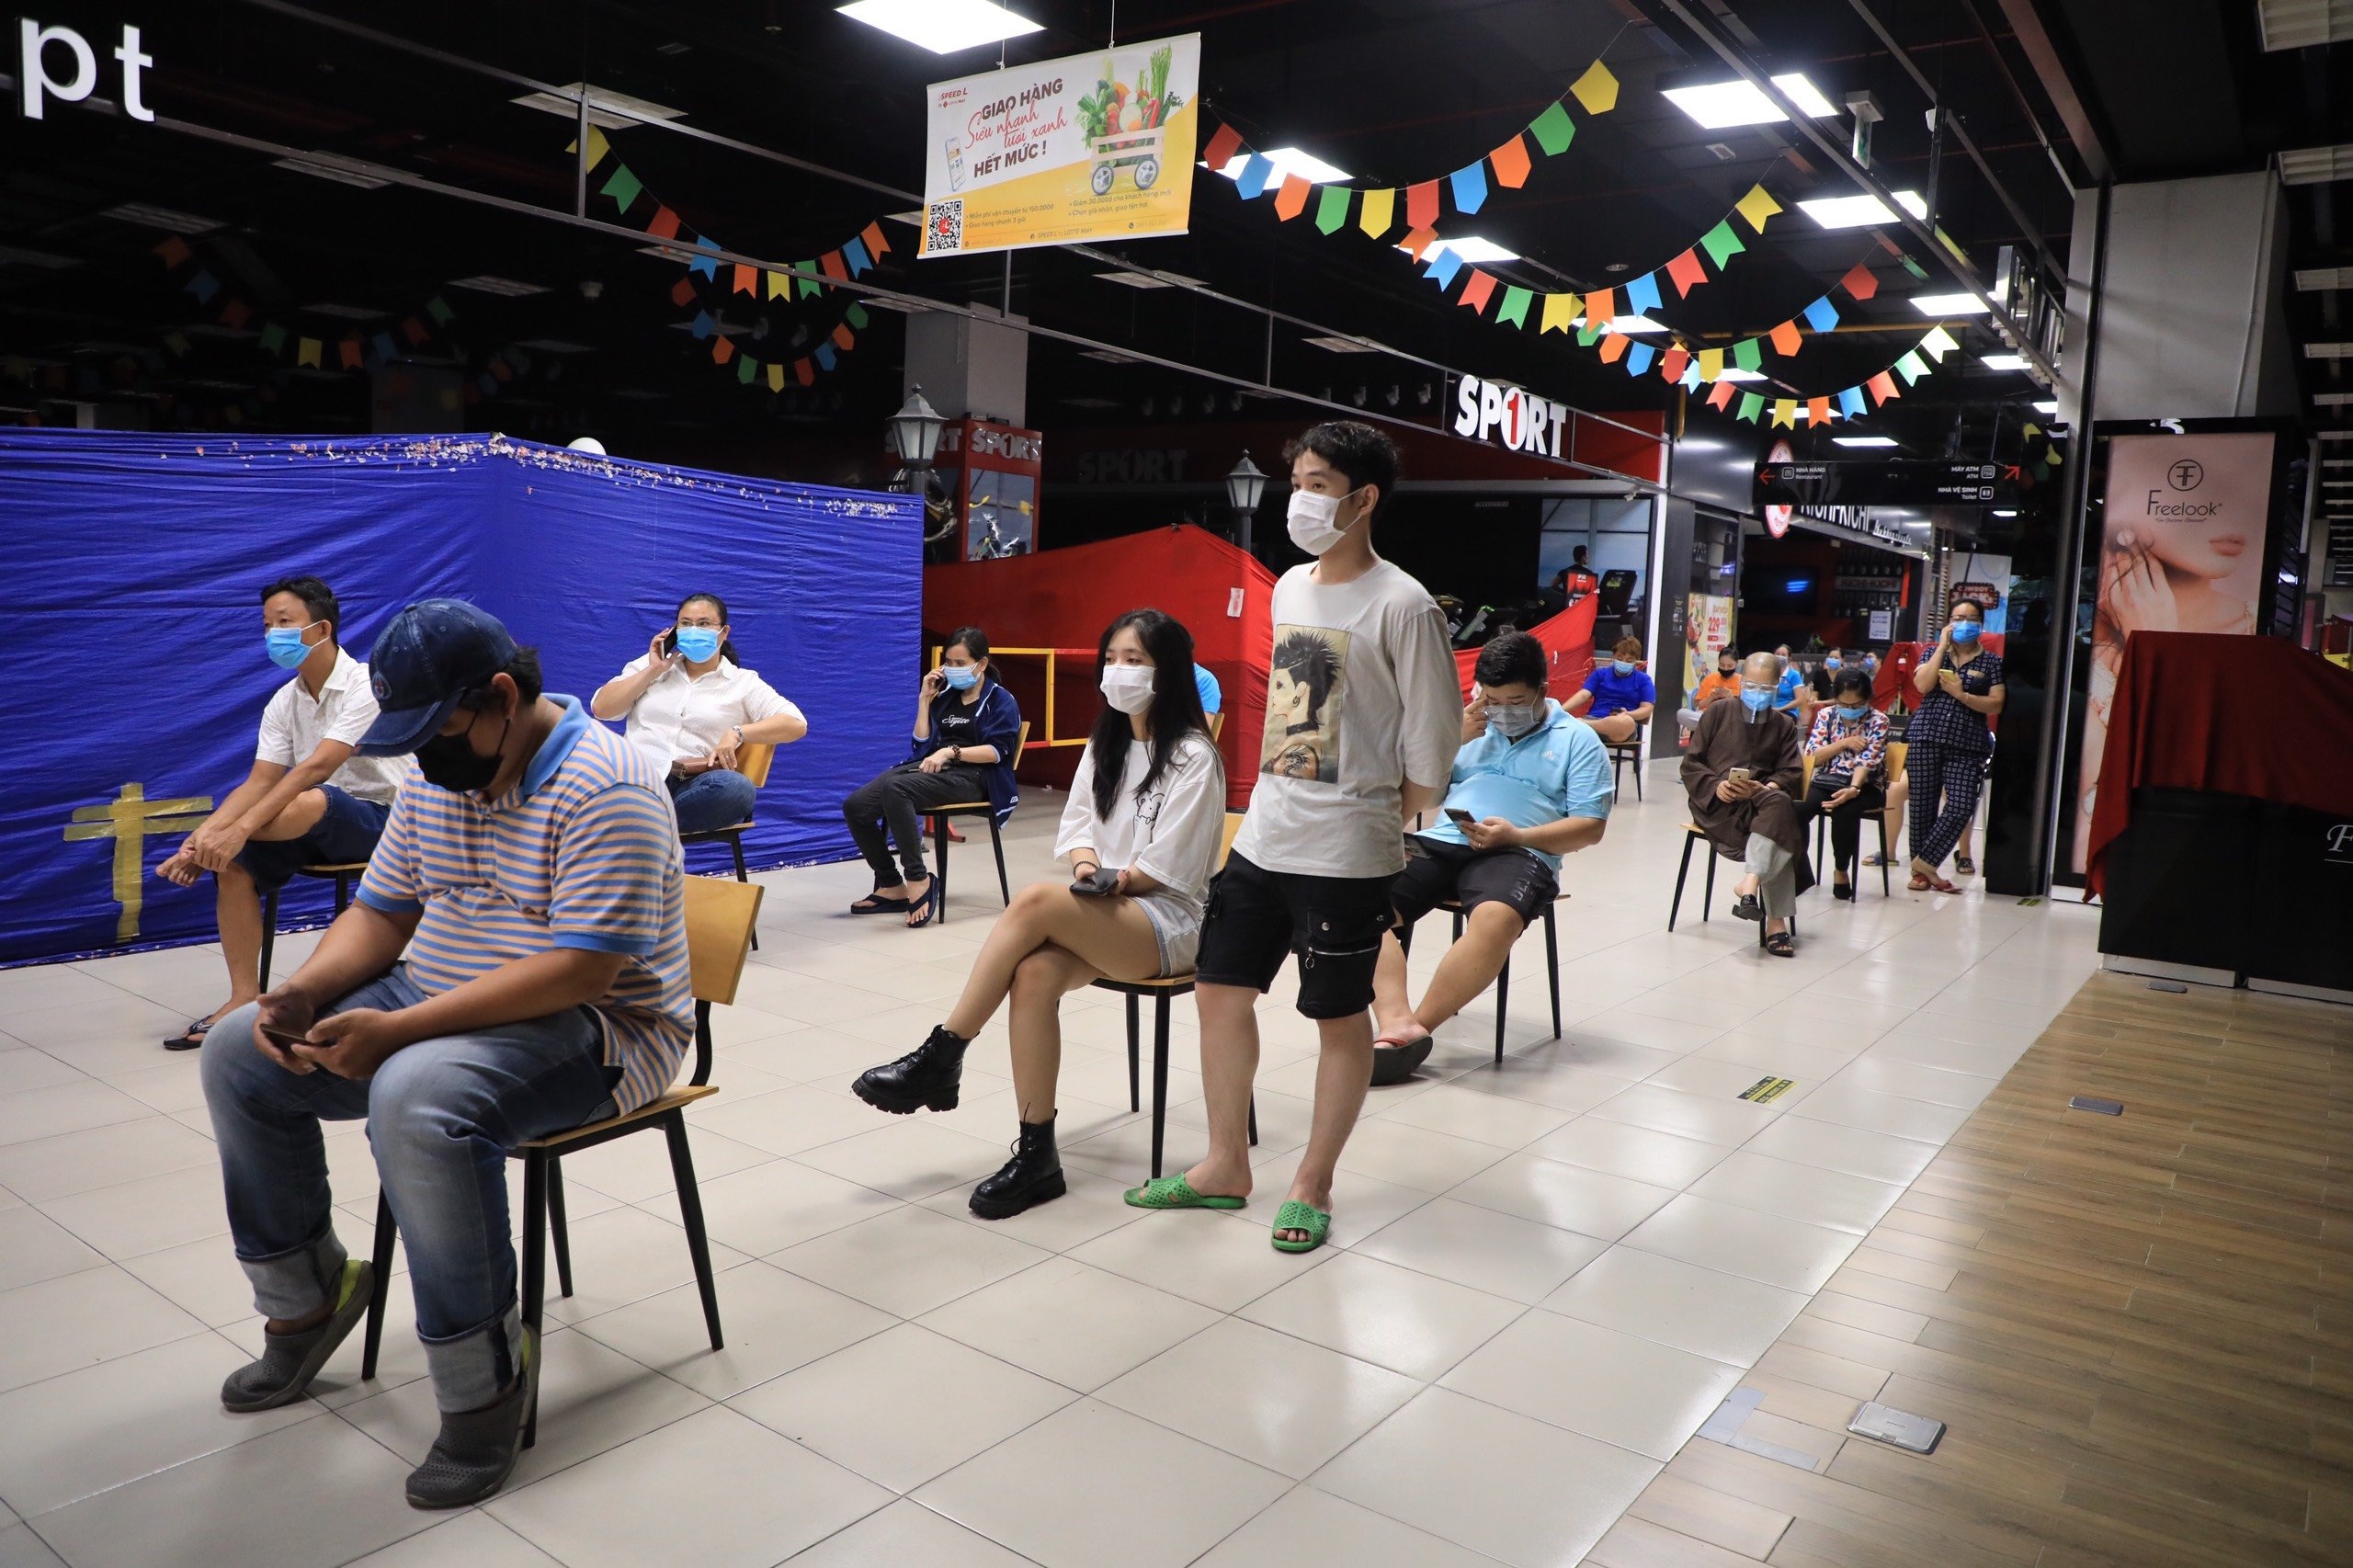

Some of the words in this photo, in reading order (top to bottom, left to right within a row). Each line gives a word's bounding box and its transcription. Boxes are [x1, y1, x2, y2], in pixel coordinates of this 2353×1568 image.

[941, 90, 961, 99] SPEED
[982, 96, 1017, 120] GIAO
[1020, 78, 1063, 107] HÀNG
[997, 98, 1039, 134] nhanh
[1031, 106, 1068, 139] xanh
[974, 153, 1001, 177] HẾT
[1005, 142, 1039, 168] MỨC
